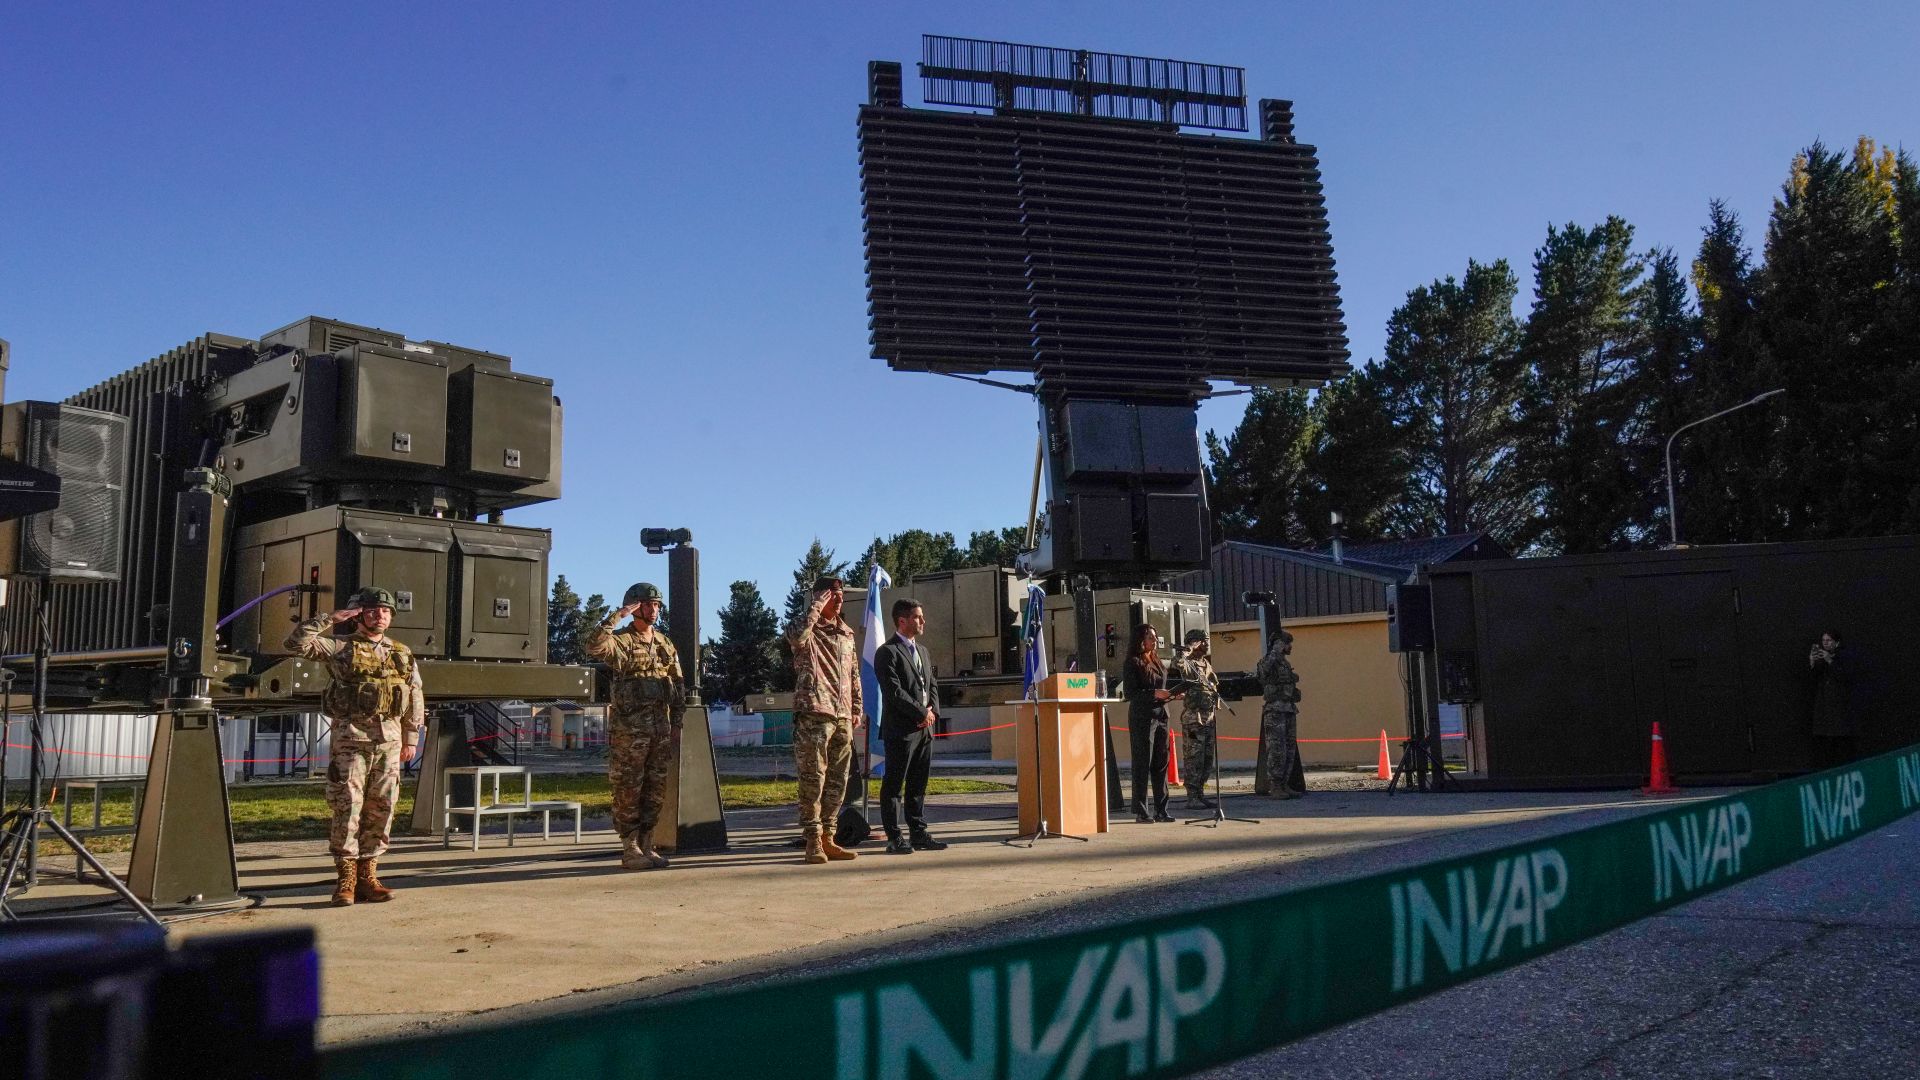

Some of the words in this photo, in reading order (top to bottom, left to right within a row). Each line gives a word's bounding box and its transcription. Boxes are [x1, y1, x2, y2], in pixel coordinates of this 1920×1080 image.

[1067, 678, 1088, 688] INVAP
[1799, 771, 1865, 847] INVAP
[1898, 751, 1920, 808] IN
[1649, 802, 1752, 902] INVAP
[1390, 848, 1568, 992] INVAP
[835, 926, 1226, 1080] INVAP
